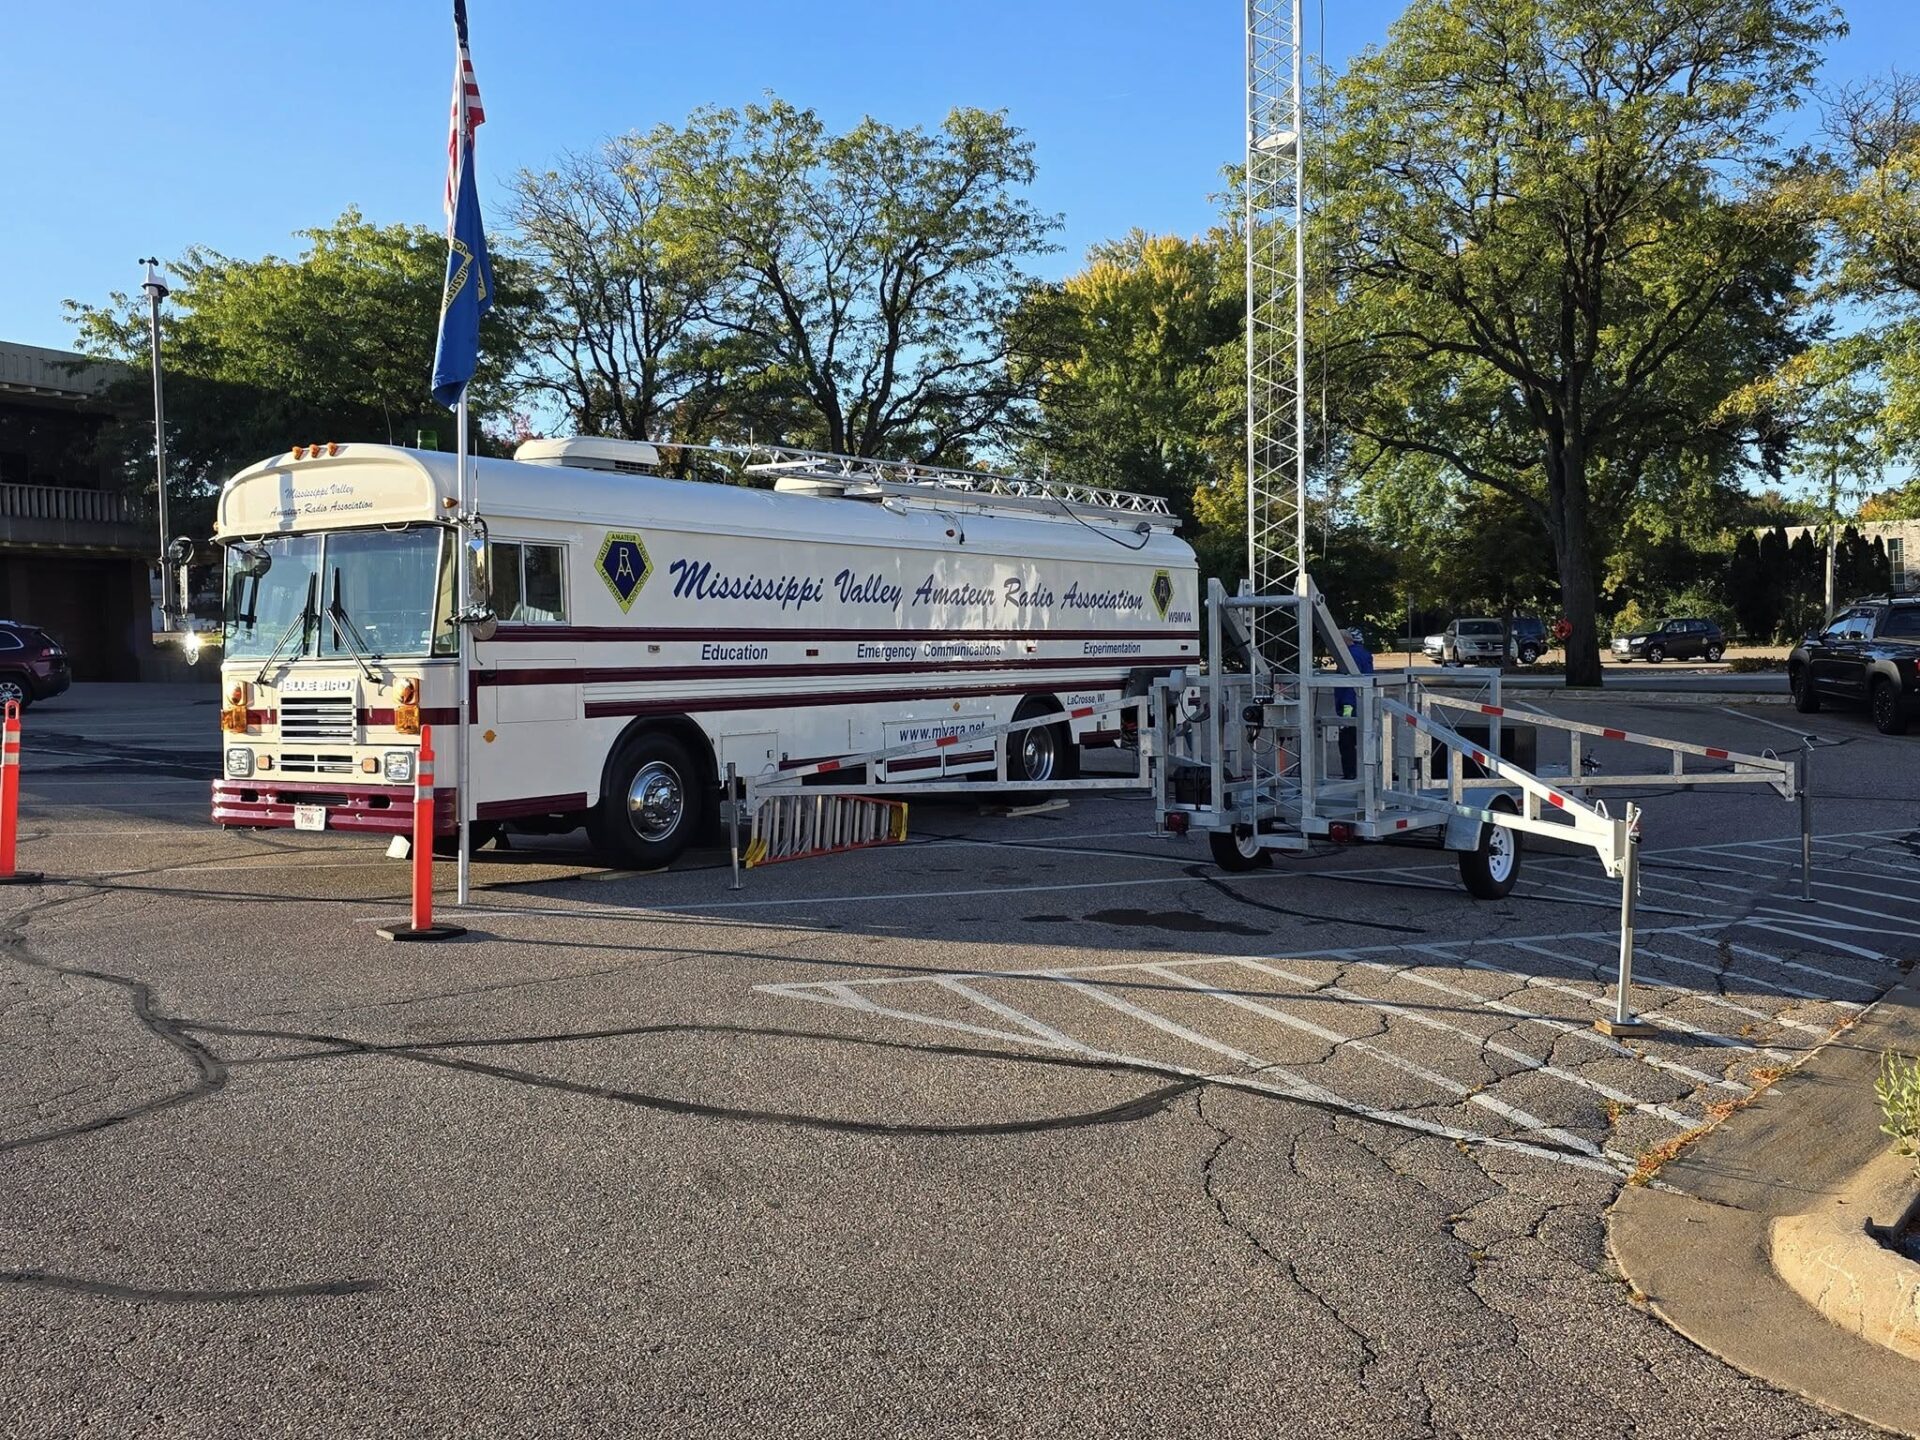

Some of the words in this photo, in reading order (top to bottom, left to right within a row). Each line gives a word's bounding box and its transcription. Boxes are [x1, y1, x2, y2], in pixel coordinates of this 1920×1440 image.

[284, 487, 328, 500] Mississippi
[330, 483, 354, 495] Valley
[269, 506, 301, 518] Amateur
[304, 503, 327, 514] Radio
[329, 501, 373, 512] Association
[611, 533, 636, 541] AMATEUR
[599, 539, 611, 561] VALLEY
[638, 542, 649, 563] RADIO
[600, 568, 623, 603] MISSISSIPPI
[627, 569, 649, 605] ASSOCIATION
[669, 558, 824, 611] Mississippi
[834, 568, 903, 612] Valley
[912, 574, 996, 608] Amateur
[1003, 577, 1054, 608] Radio
[1061, 581, 1144, 610] Association
[1168, 611, 1192, 623] W9MVA
[701, 643, 768, 660] Education
[857, 643, 916, 661] Emergency
[923, 642, 1001, 657] Communications
[1083, 642, 1141, 656] Experimentation
[1066, 694, 1097, 705] LaCrosse,
[1097, 693, 1105, 703] WI
[899, 721, 985, 741] www.mvaranet
